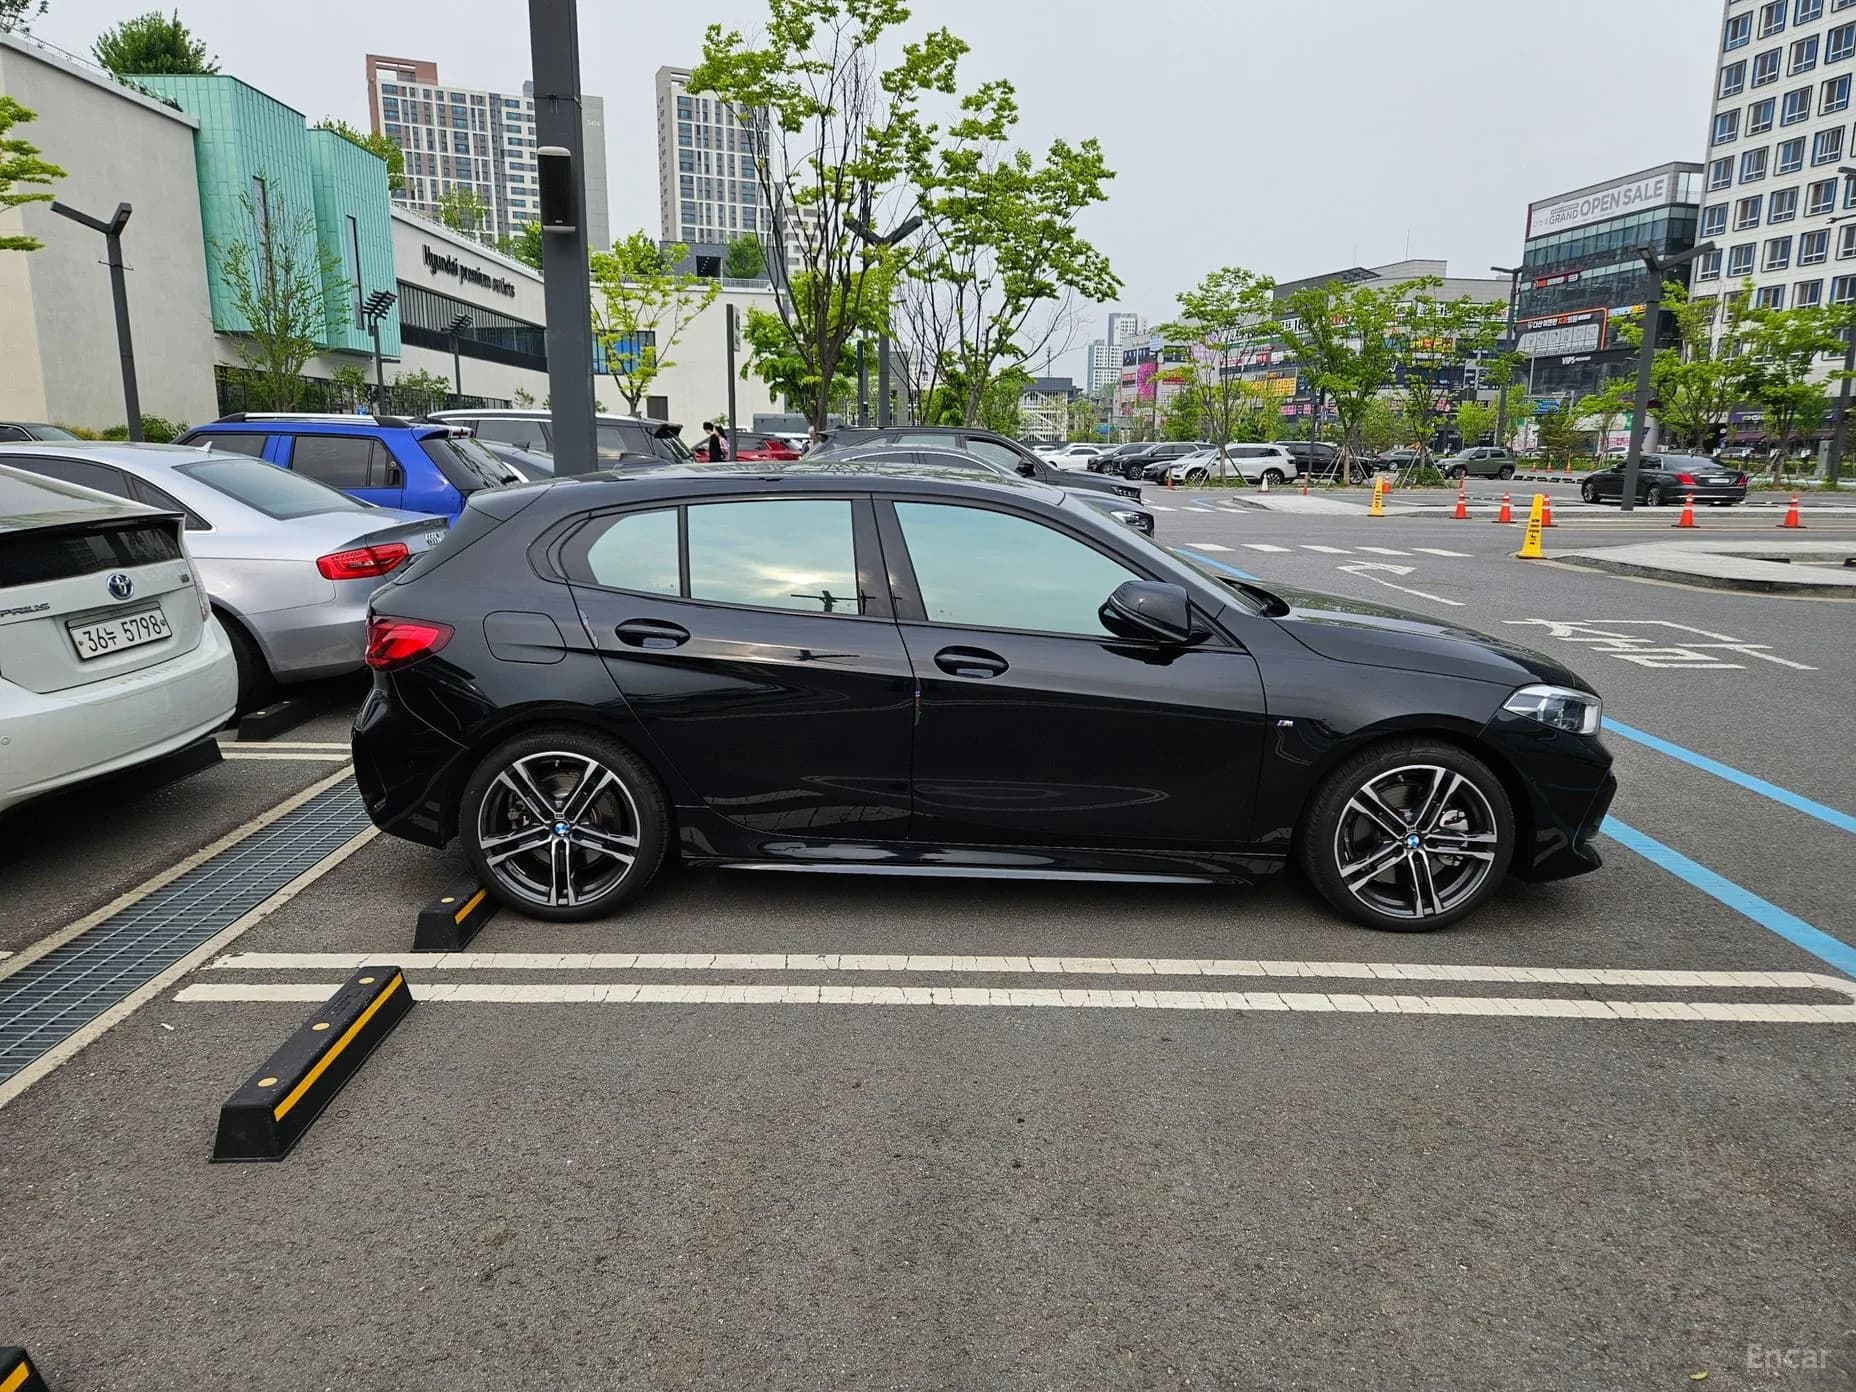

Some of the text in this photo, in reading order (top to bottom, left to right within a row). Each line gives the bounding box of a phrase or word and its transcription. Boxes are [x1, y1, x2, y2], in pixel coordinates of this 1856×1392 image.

[1549, 209, 1579, 225] GRAND
[1580, 191, 1621, 217] OPEN
[1622, 179, 1665, 206] SALE
[422, 244, 458, 276] Hyundai
[459, 264, 491, 289] premium
[0, 602, 51, 617] PRIUS
[83, 615, 162, 652] 36누 5798
